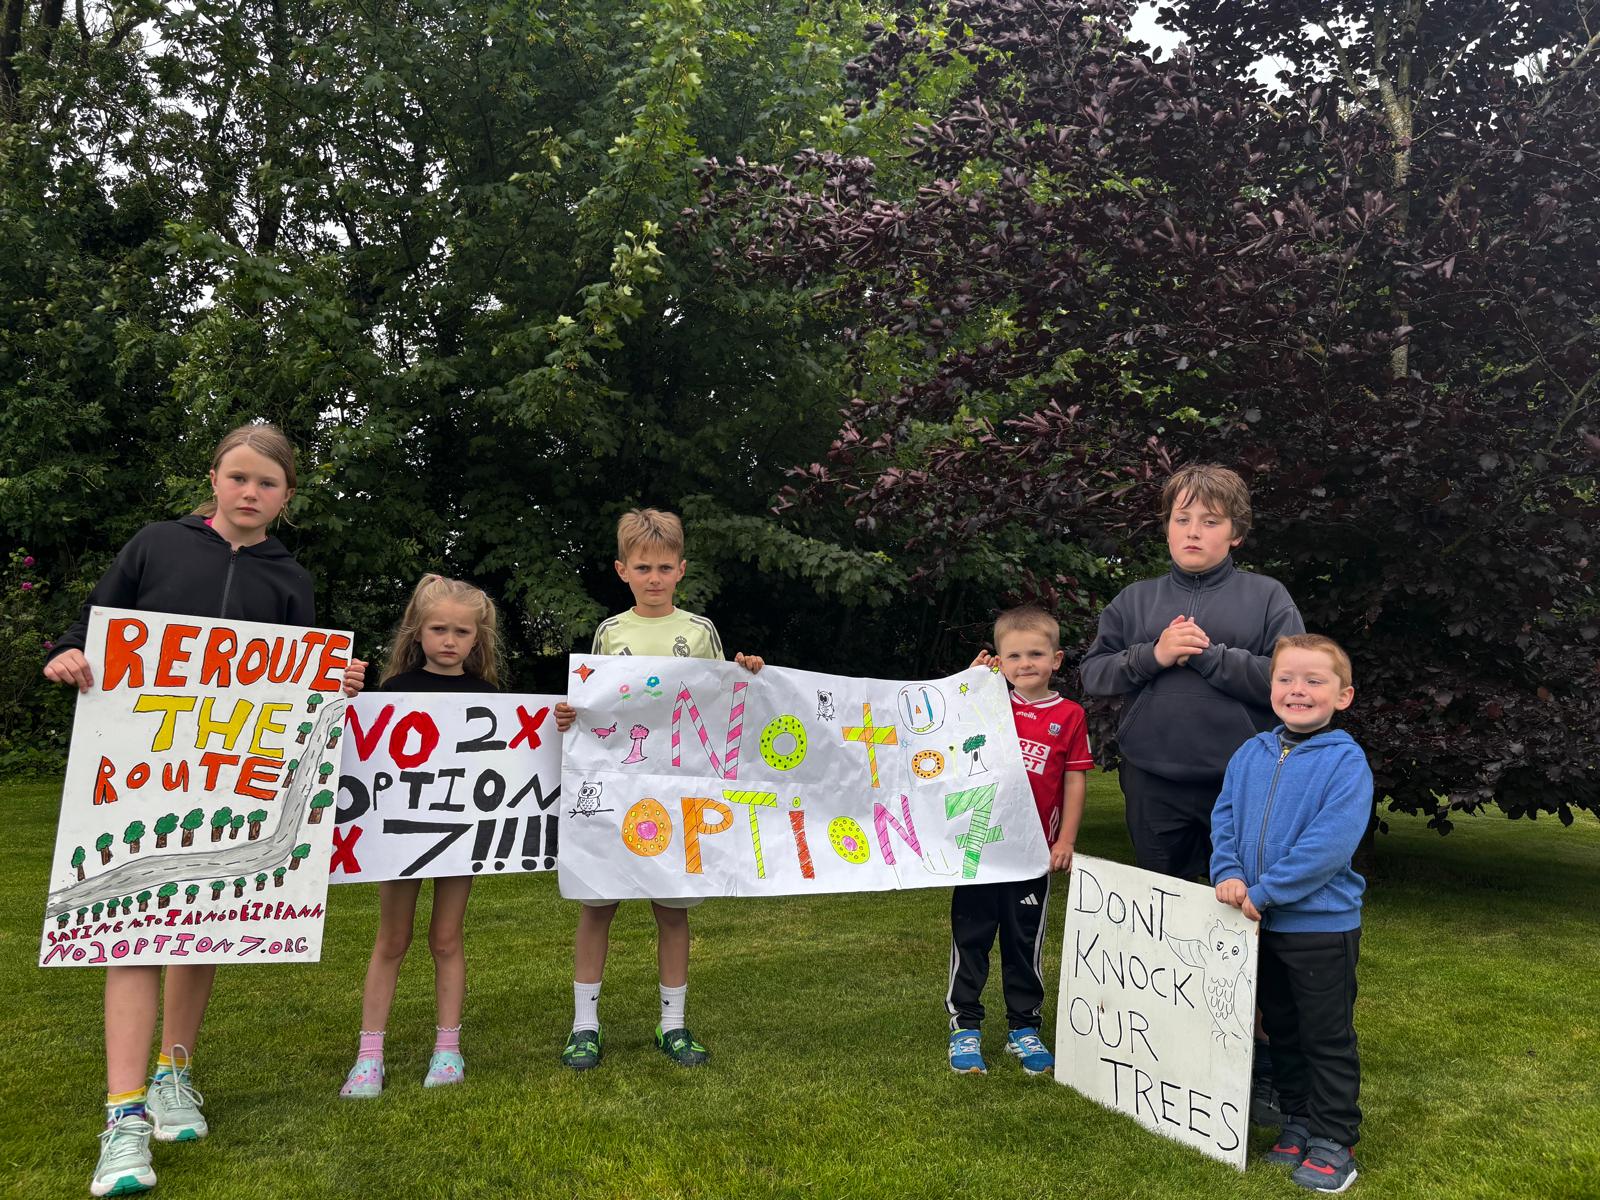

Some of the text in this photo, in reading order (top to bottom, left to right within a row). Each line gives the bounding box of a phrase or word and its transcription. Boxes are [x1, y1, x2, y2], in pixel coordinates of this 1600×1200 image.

[102, 617, 351, 692] REROUTE
[132, 694, 294, 759] THE
[344, 703, 440, 769] NO
[671, 681, 808, 780] No
[1019, 740, 1046, 757] RTS
[93, 752, 286, 806] ROUTE
[335, 768, 561, 824] OPTION
[944, 782, 1005, 880] 7
[47, 921, 124, 946] SAYING
[1074, 930, 1195, 1009] KNOCK
[1069, 996, 1159, 1062] OUR
[1100, 1057, 1240, 1151] TREES
